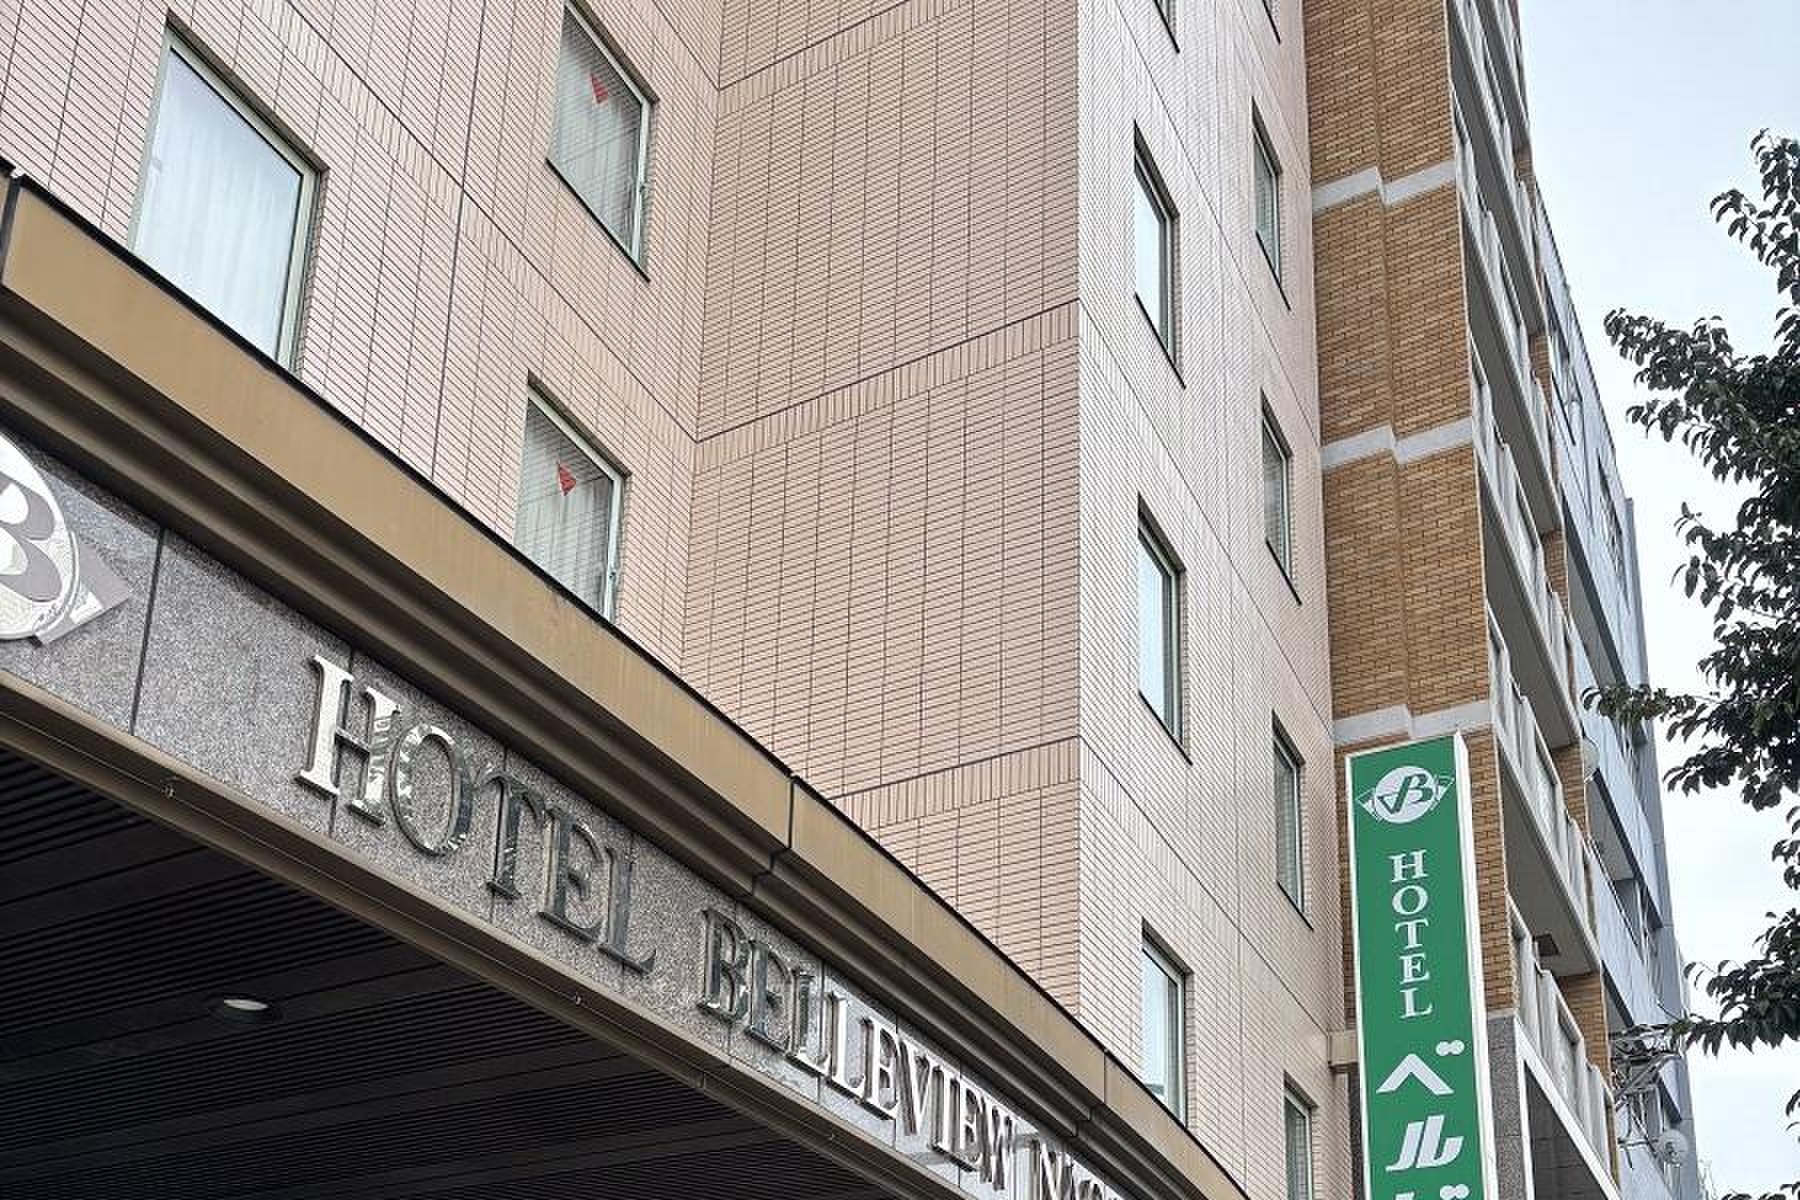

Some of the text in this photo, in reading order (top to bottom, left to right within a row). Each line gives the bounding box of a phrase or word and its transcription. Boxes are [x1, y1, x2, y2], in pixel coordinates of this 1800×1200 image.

[294, 654, 656, 974] HOTEL
[697, 908, 1017, 1191] BELLEVIEW
[1388, 849, 1433, 1019] HOTEL
